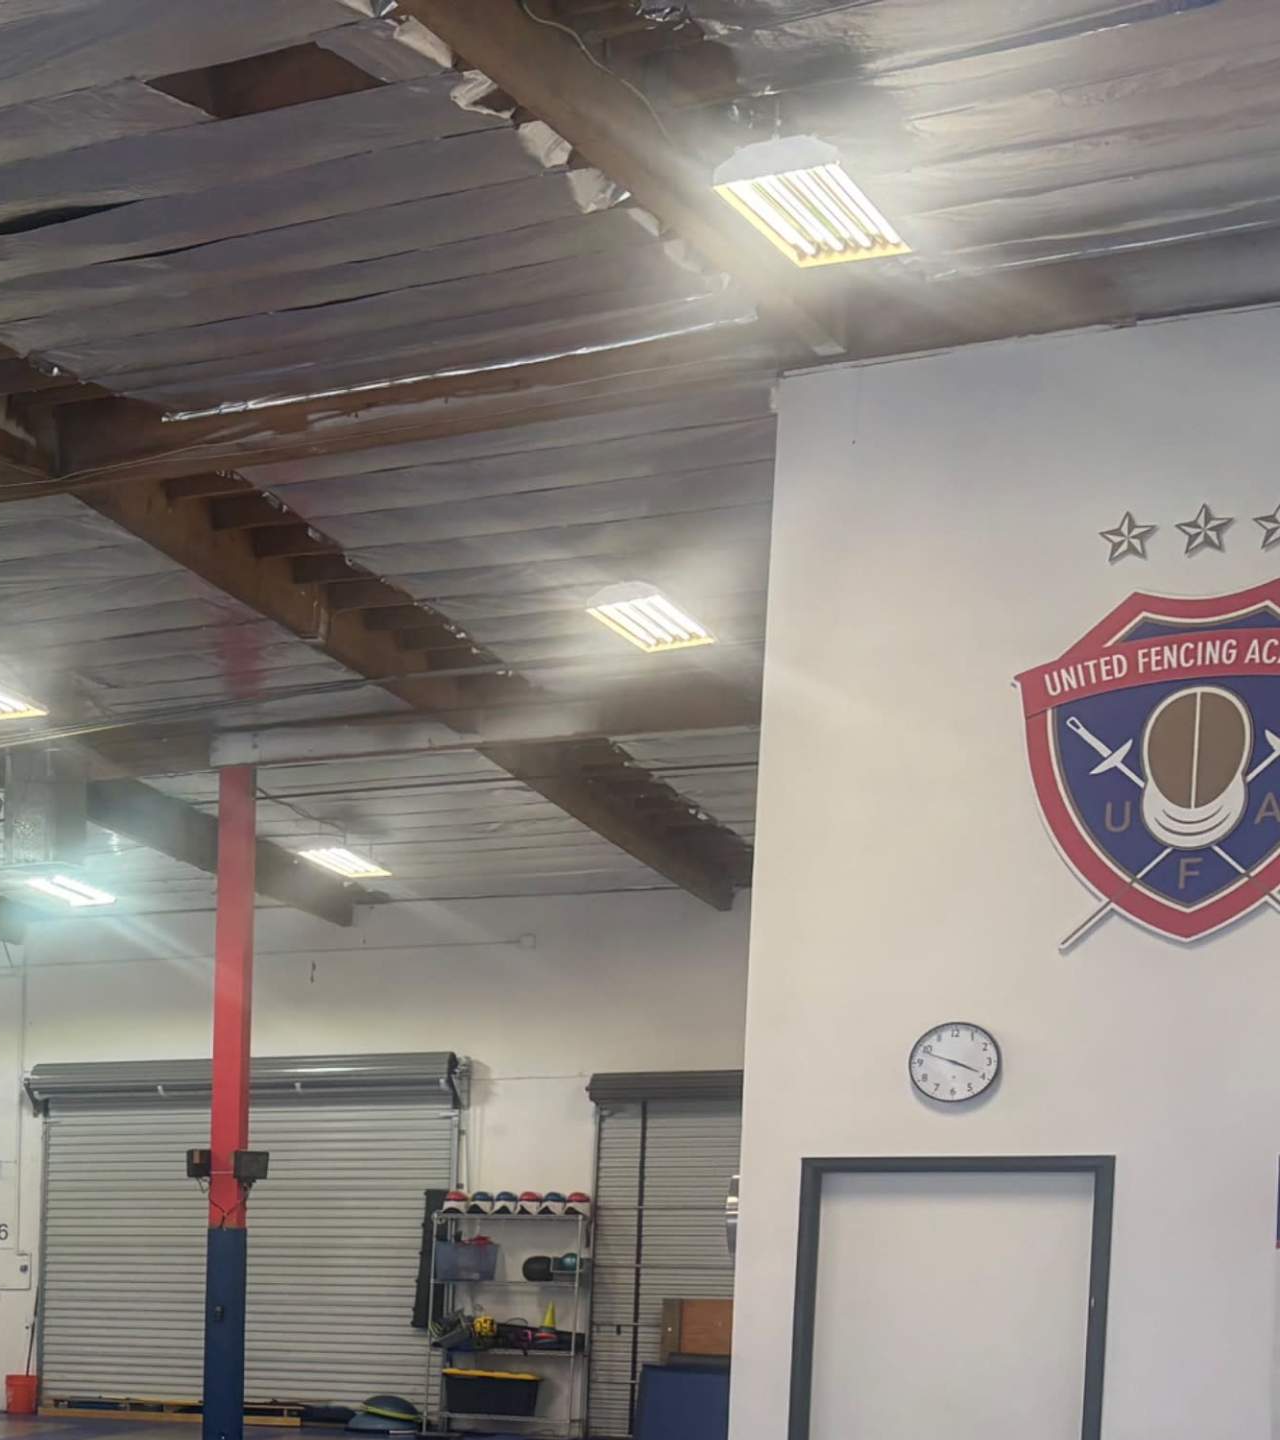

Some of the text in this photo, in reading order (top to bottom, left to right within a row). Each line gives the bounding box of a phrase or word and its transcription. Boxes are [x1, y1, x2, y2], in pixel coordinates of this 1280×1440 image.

[1044, 638, 1280, 696] UNITED FENCING AC
[1104, 792, 1280, 832] U A
[1178, 857, 1203, 889] F
[982, 1042, 988, 1052] 2
[986, 1057, 992, 1066] 3
[934, 1083, 940, 1092] 7
